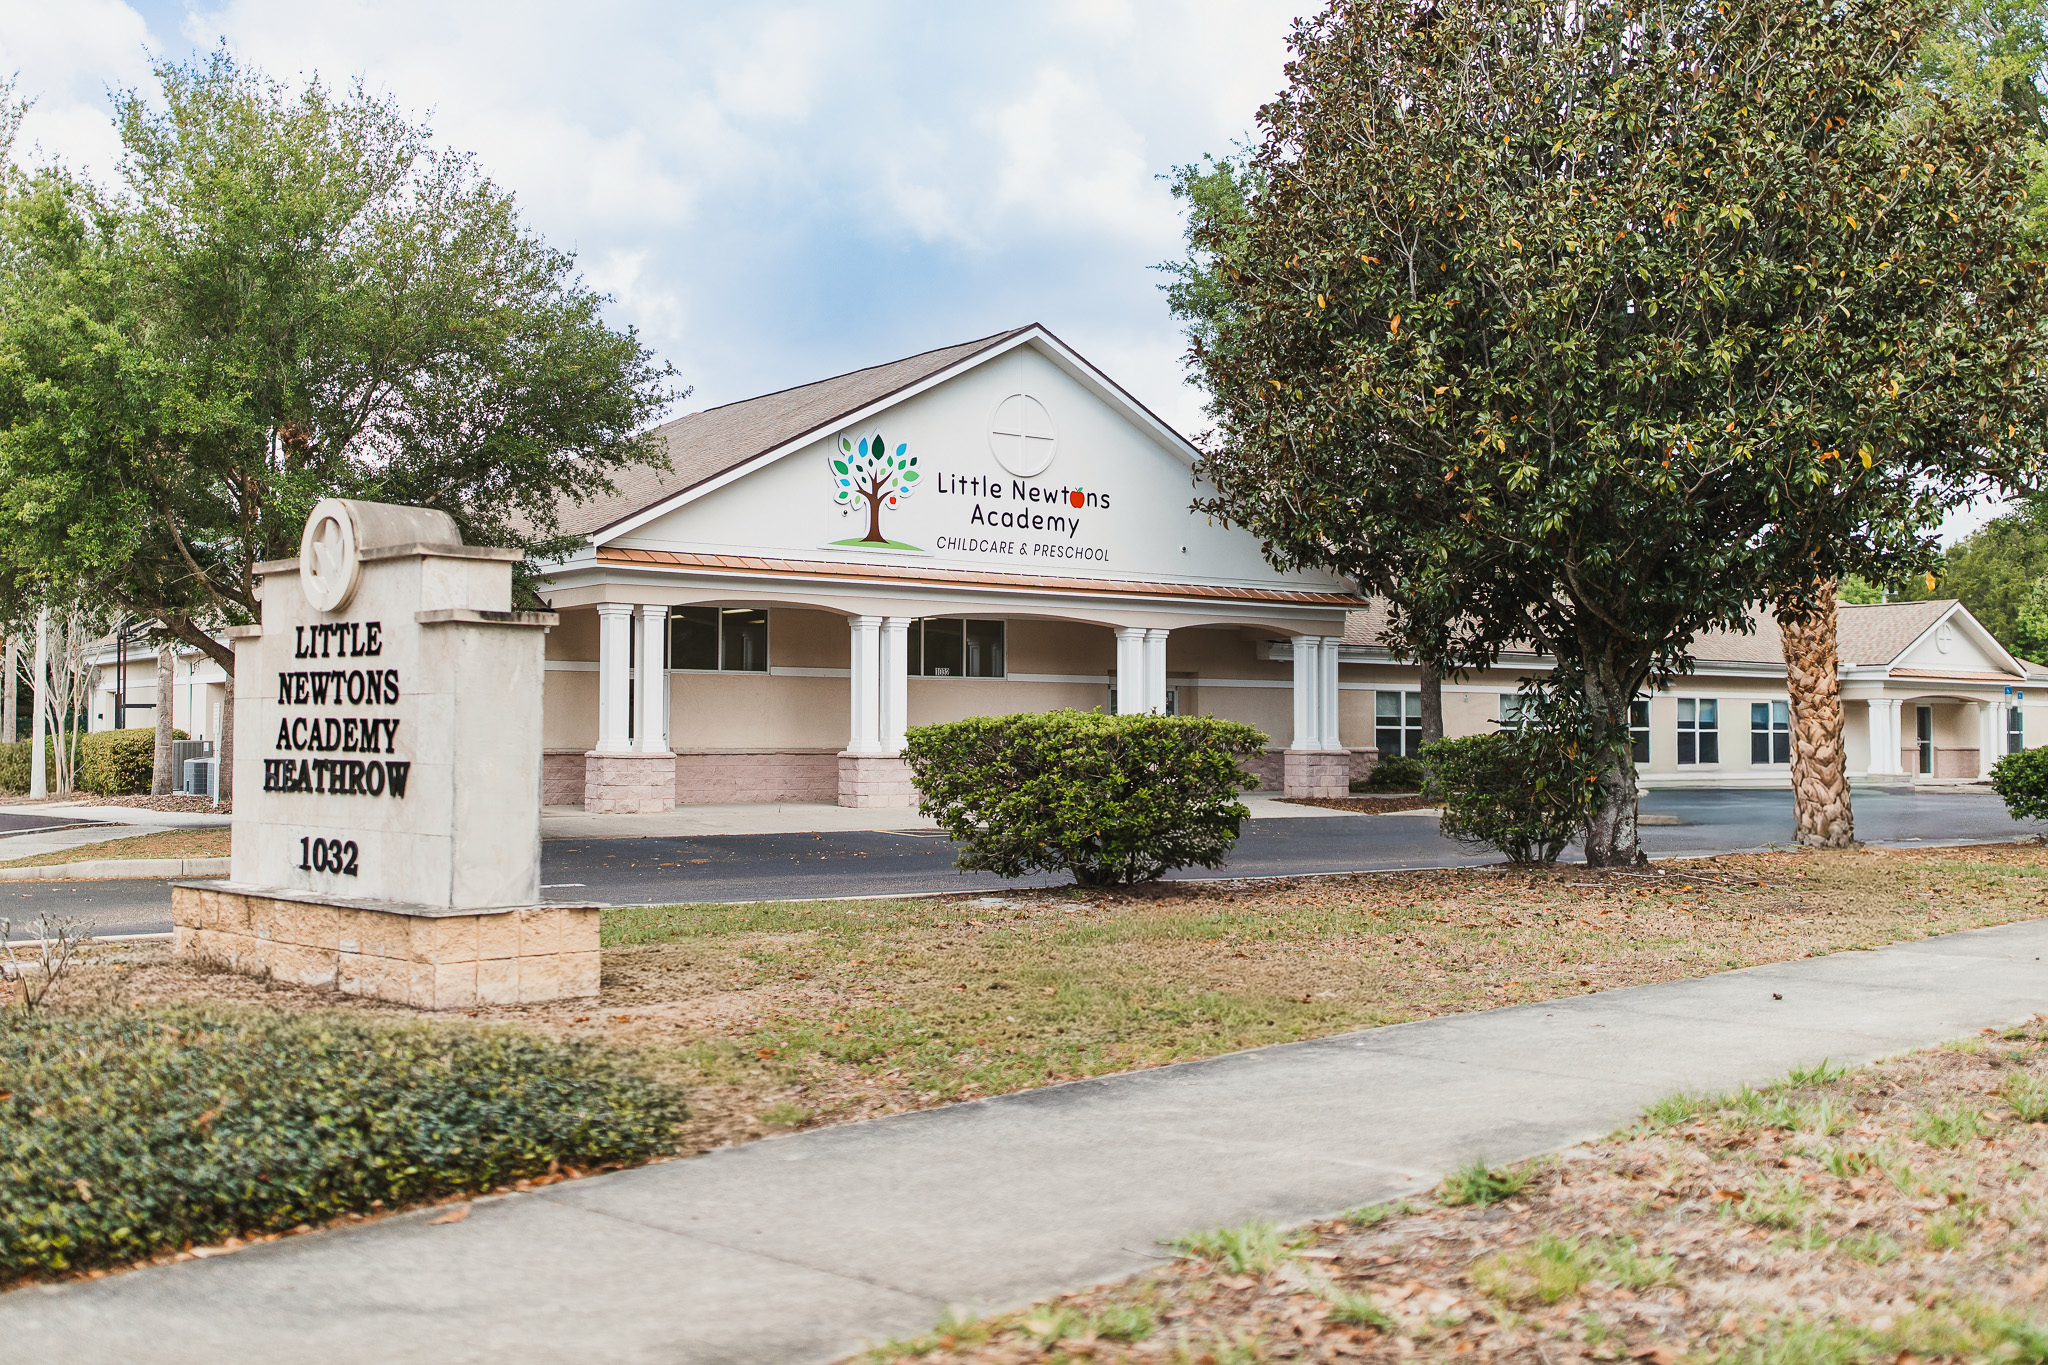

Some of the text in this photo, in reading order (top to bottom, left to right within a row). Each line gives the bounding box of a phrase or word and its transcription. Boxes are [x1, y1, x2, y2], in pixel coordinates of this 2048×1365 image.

[938, 471, 1002, 499] Little
[970, 503, 1080, 539] Academy
[936, 536, 1110, 562] CHILDCARE & PRESCHOOL
[294, 621, 383, 659] LITTLE
[277, 669, 400, 706] NEWTONS
[275, 717, 400, 754] ACADEMY
[263, 758, 411, 799] HEATHROW
[299, 836, 359, 877] 1032
